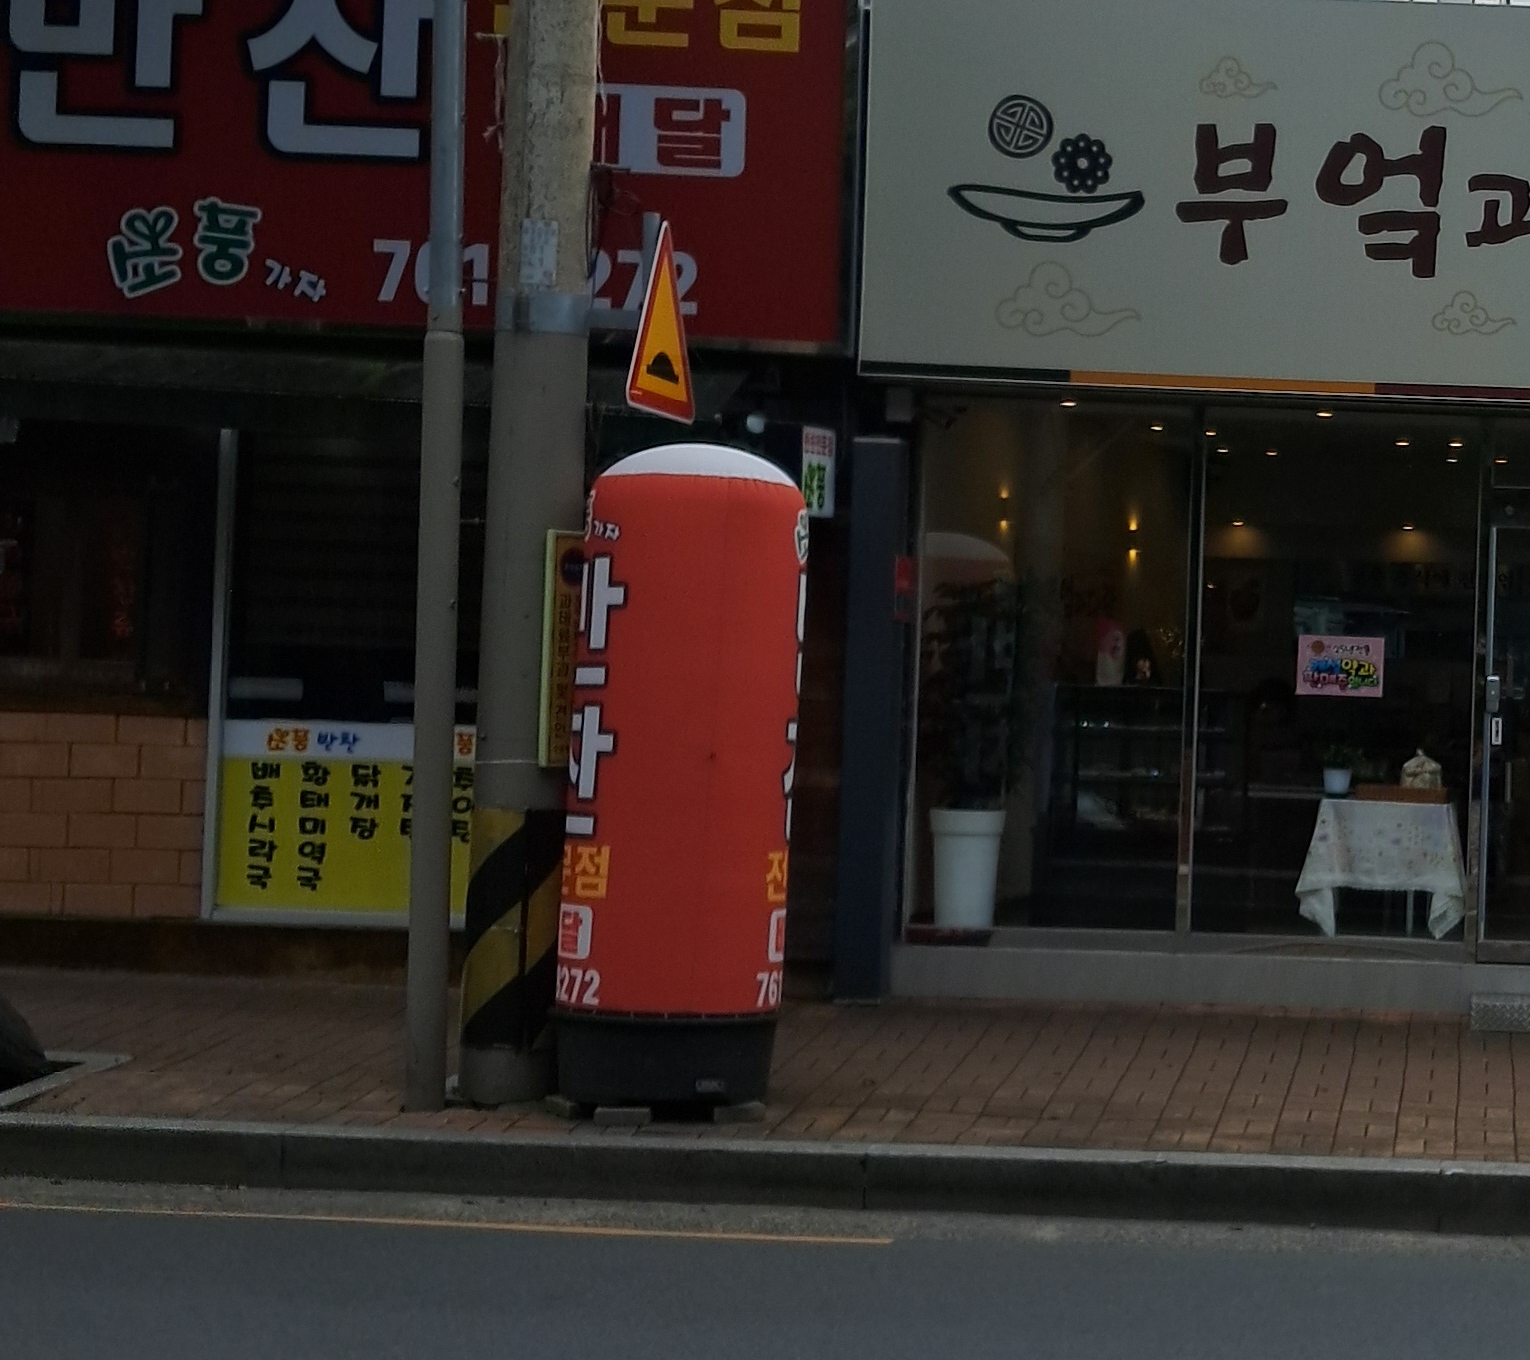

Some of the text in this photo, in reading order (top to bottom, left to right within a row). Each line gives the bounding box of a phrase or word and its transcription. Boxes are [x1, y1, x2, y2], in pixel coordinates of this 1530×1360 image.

[264, 258, 328, 303] 가자
[316, 730, 360, 753] 반찬
[297, 761, 331, 892] 황태미역국
[350, 763, 382, 841] 닭개장
